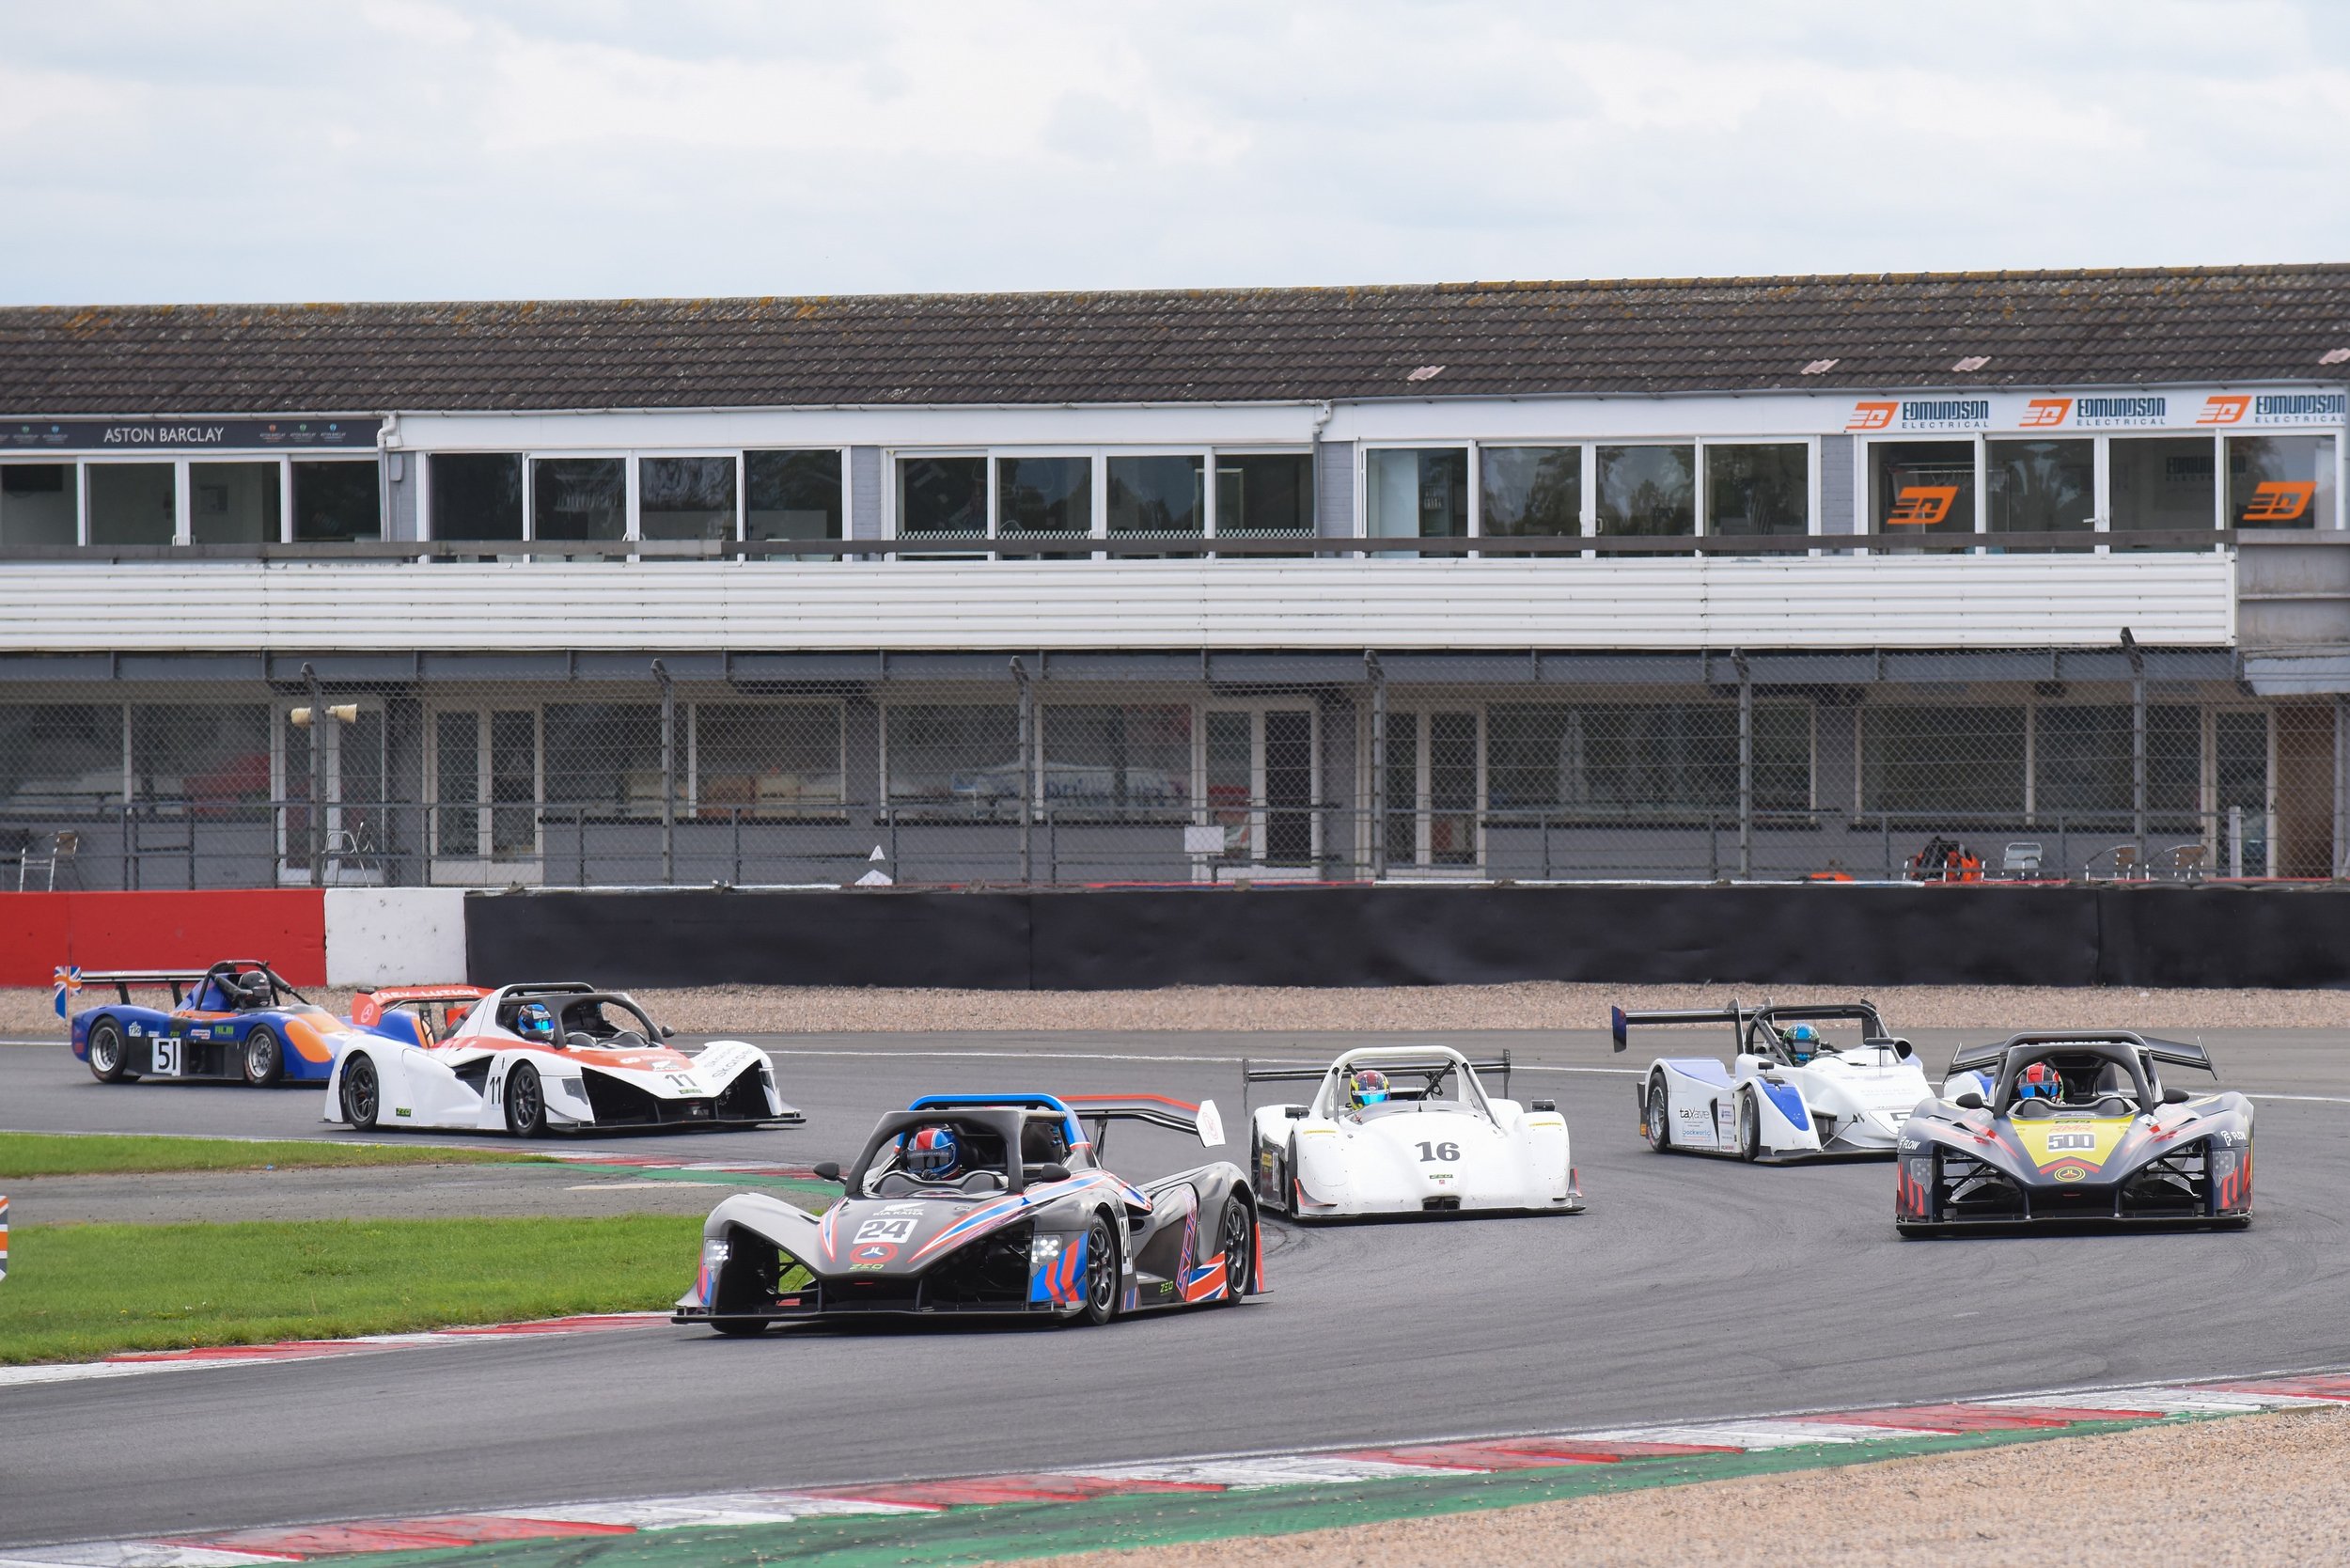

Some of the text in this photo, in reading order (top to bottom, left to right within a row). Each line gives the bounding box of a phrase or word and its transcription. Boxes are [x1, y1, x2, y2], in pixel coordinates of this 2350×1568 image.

[1903, 400, 1988, 420] EDMUNDSON
[2077, 398, 2165, 417] EDMUNDSON
[2256, 395, 2344, 415] EDMUNDSON
[103, 427, 224, 443] ASTON BARCLAY
[159, 1041, 176, 1071] 51
[666, 1074, 697, 1087] 11
[490, 1076, 501, 1105] 11
[1415, 1141, 1460, 1162] 16
[1903, 1139, 1920, 1151] FLOW
[2048, 1134, 2094, 1150] 500
[858, 1220, 910, 1239] 24
[1160, 1281, 1173, 1293] ZEO
